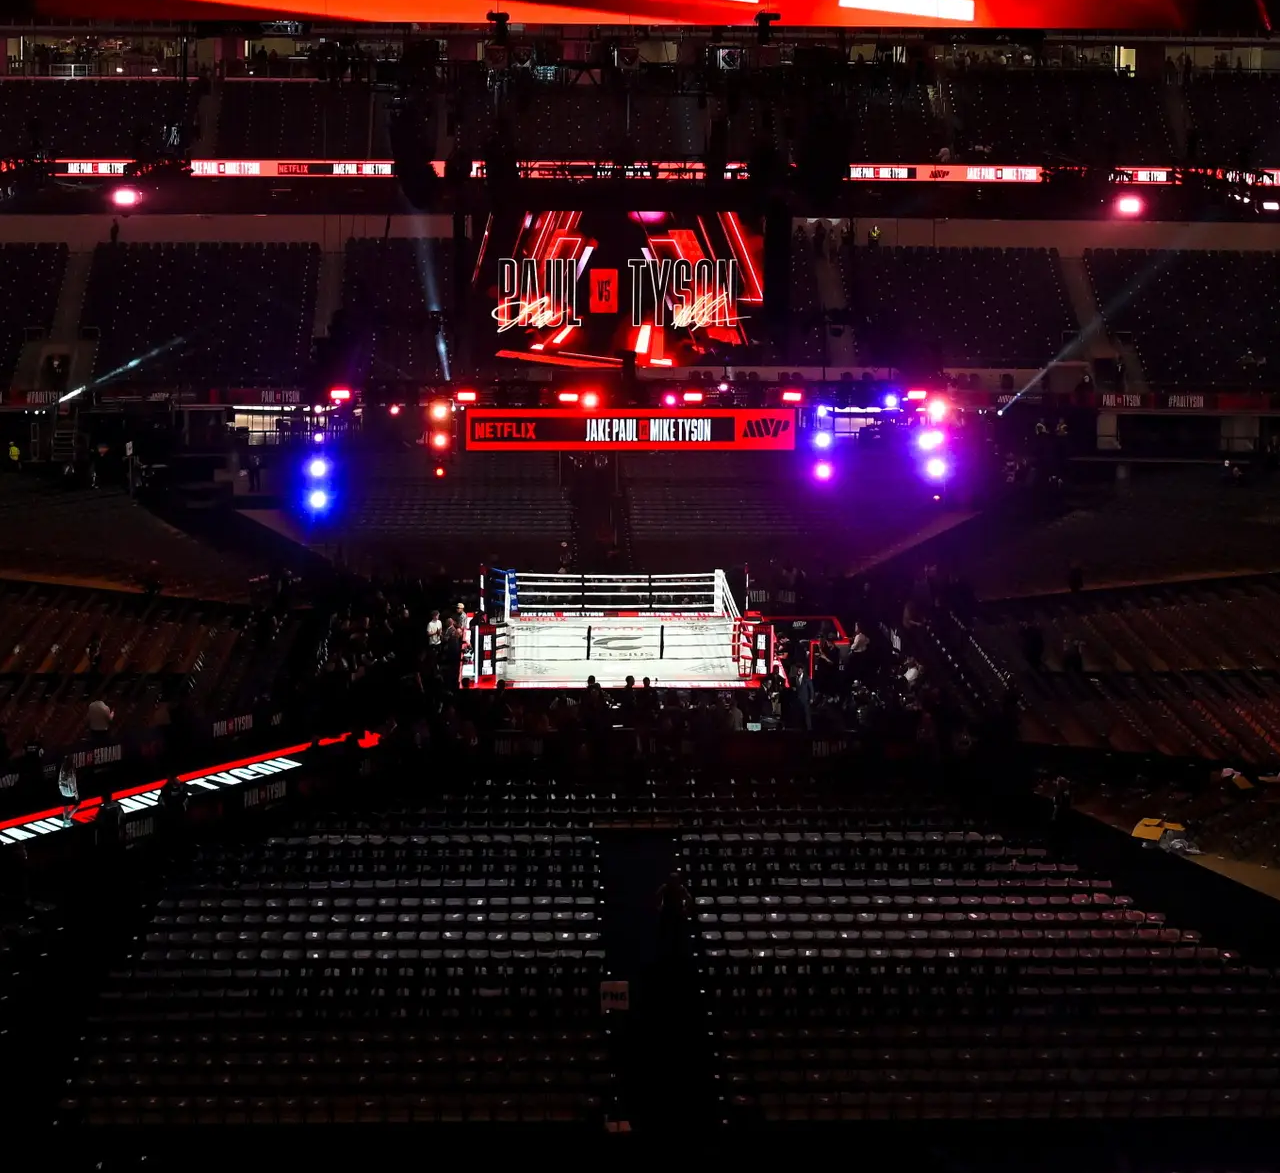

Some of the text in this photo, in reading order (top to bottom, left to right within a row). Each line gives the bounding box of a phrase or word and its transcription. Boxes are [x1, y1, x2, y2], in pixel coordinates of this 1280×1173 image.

[279, 165, 308, 173] NETFLIX
[498, 258, 582, 327] PAUL
[597, 280, 610, 301] VS
[628, 259, 738, 327] TYSON
[262, 391, 300, 403] PAUL TYSON
[1103, 395, 1141, 406] PAUL TYSON
[1169, 395, 1203, 408] #PAULTYSON
[475, 422, 536, 440] NETFLIX
[586, 419, 711, 441] JAKE PAUL MIKE TYSON
[235, 714, 253, 732] TYSON
